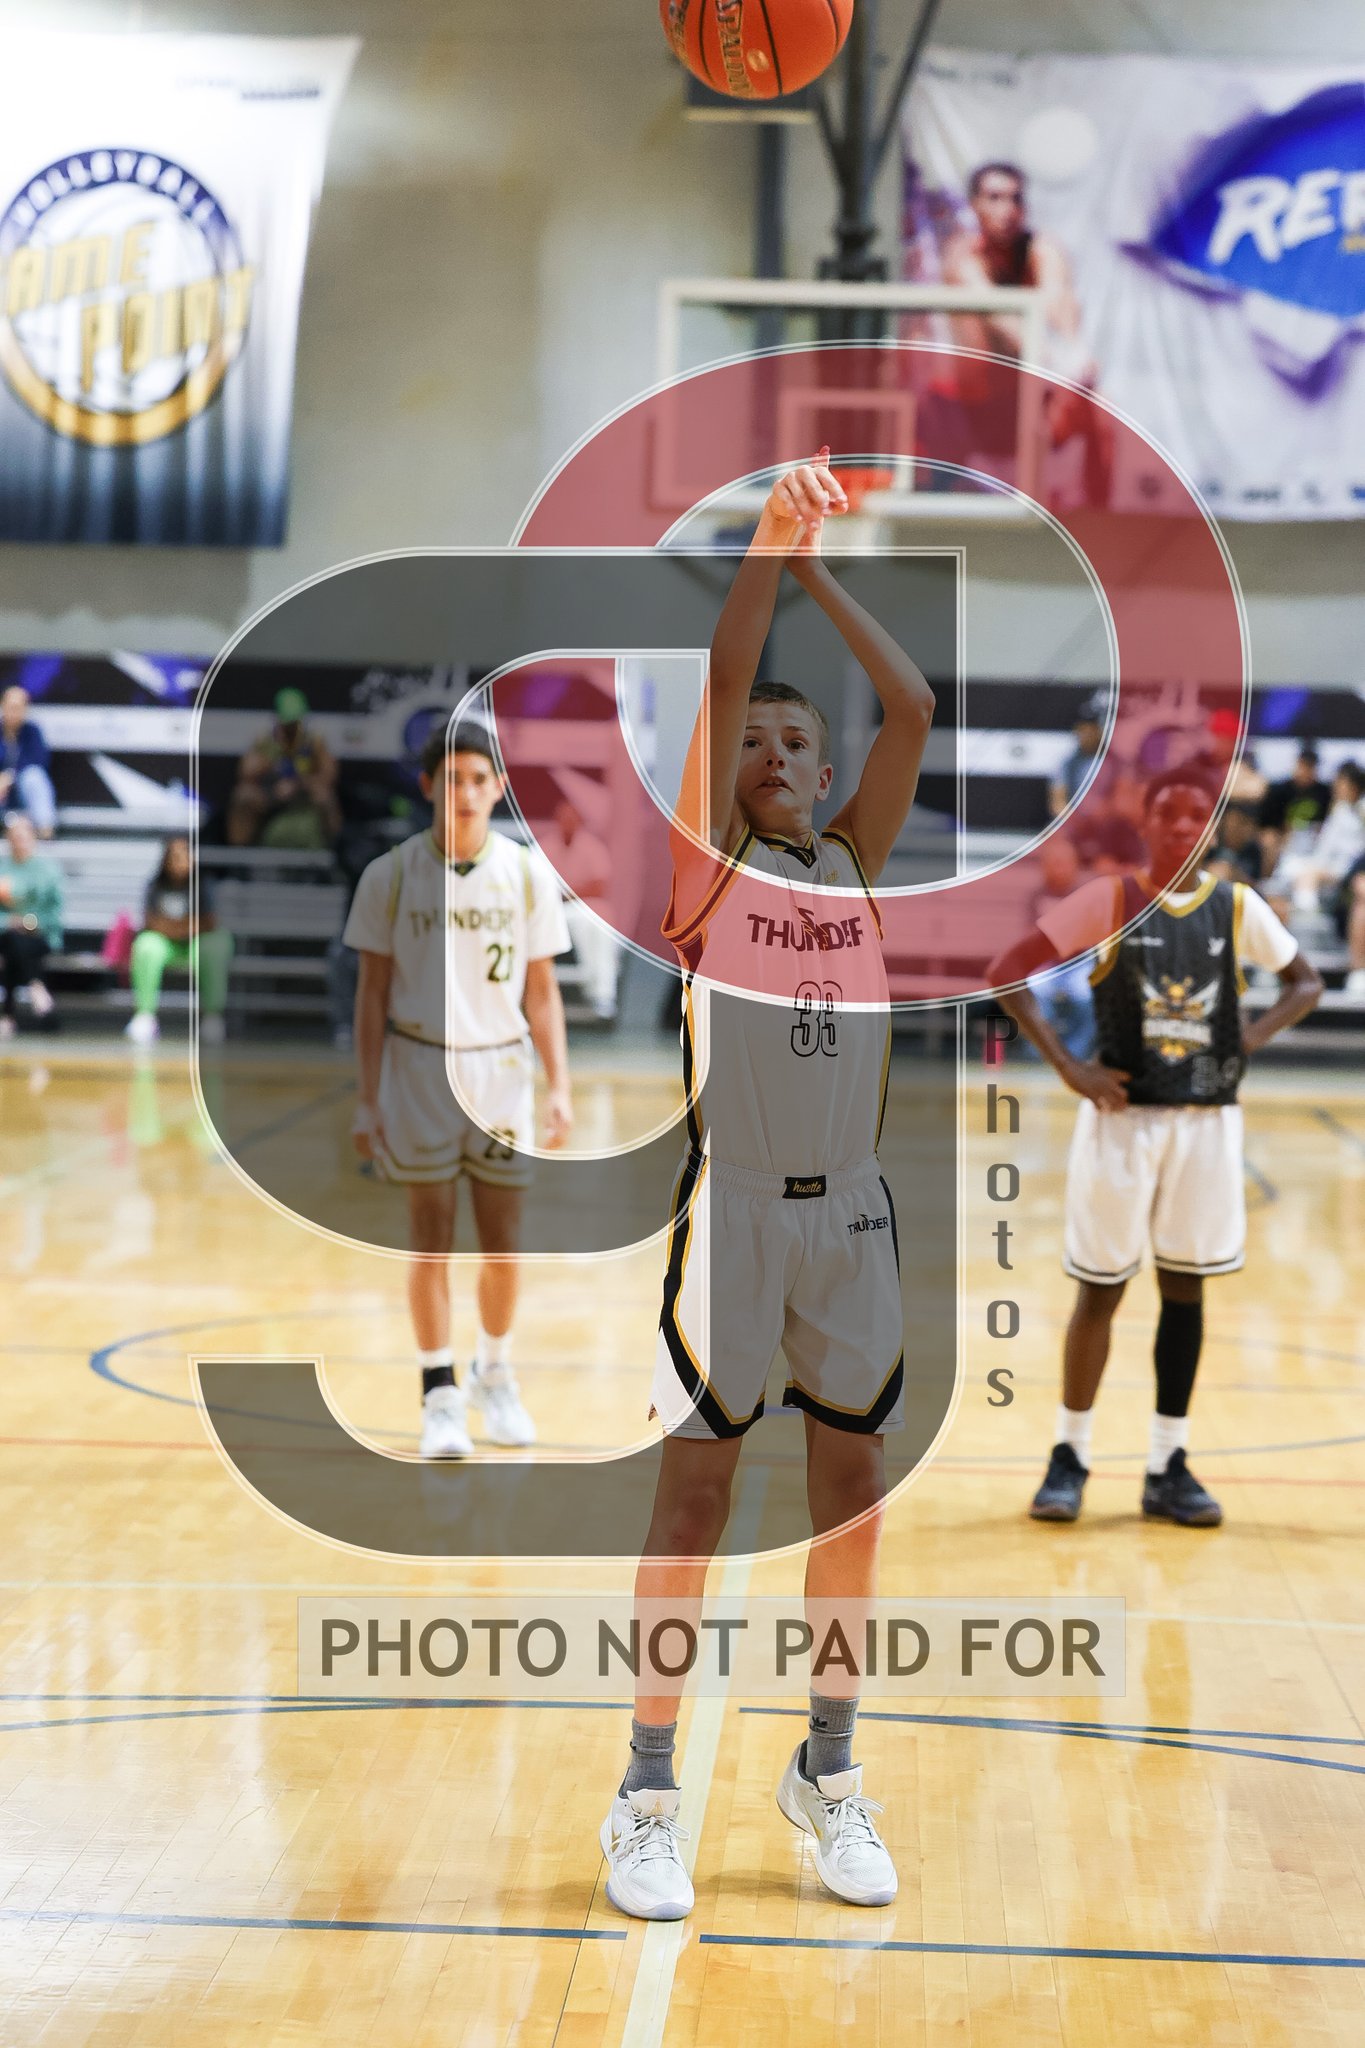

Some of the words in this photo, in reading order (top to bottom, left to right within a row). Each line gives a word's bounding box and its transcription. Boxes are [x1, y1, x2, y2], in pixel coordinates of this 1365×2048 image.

[715, 0, 753, 94] PALDIN
[790, 980, 843, 1058] 33
[793, 1181, 822, 1194] hustle
